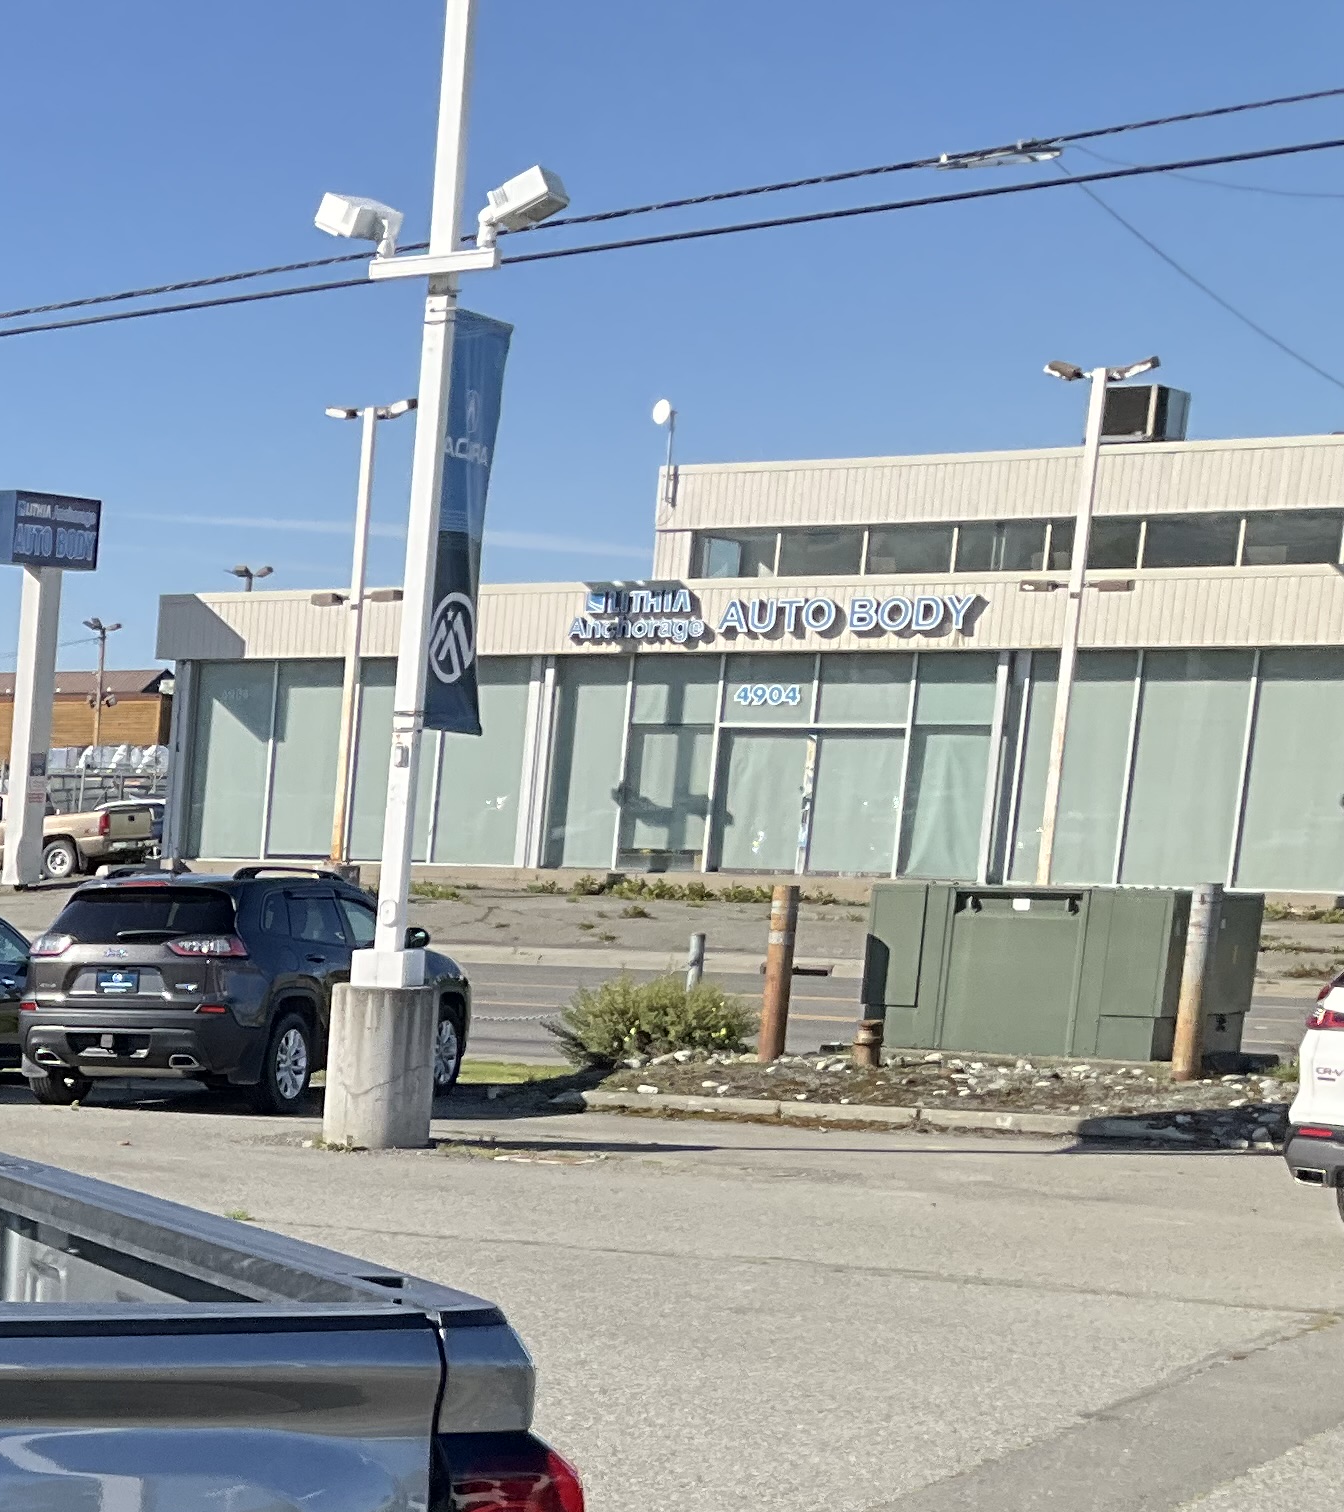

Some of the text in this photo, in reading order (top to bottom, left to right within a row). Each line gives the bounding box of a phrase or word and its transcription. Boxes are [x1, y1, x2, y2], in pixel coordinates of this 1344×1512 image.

[14, 523, 97, 561] AUTO BODY
[607, 584, 692, 614] LITHIA
[568, 594, 979, 643] Anchorage AUTO BODY
[734, 684, 801, 706] 4904
[1315, 1066, 1344, 1078] CR-V
